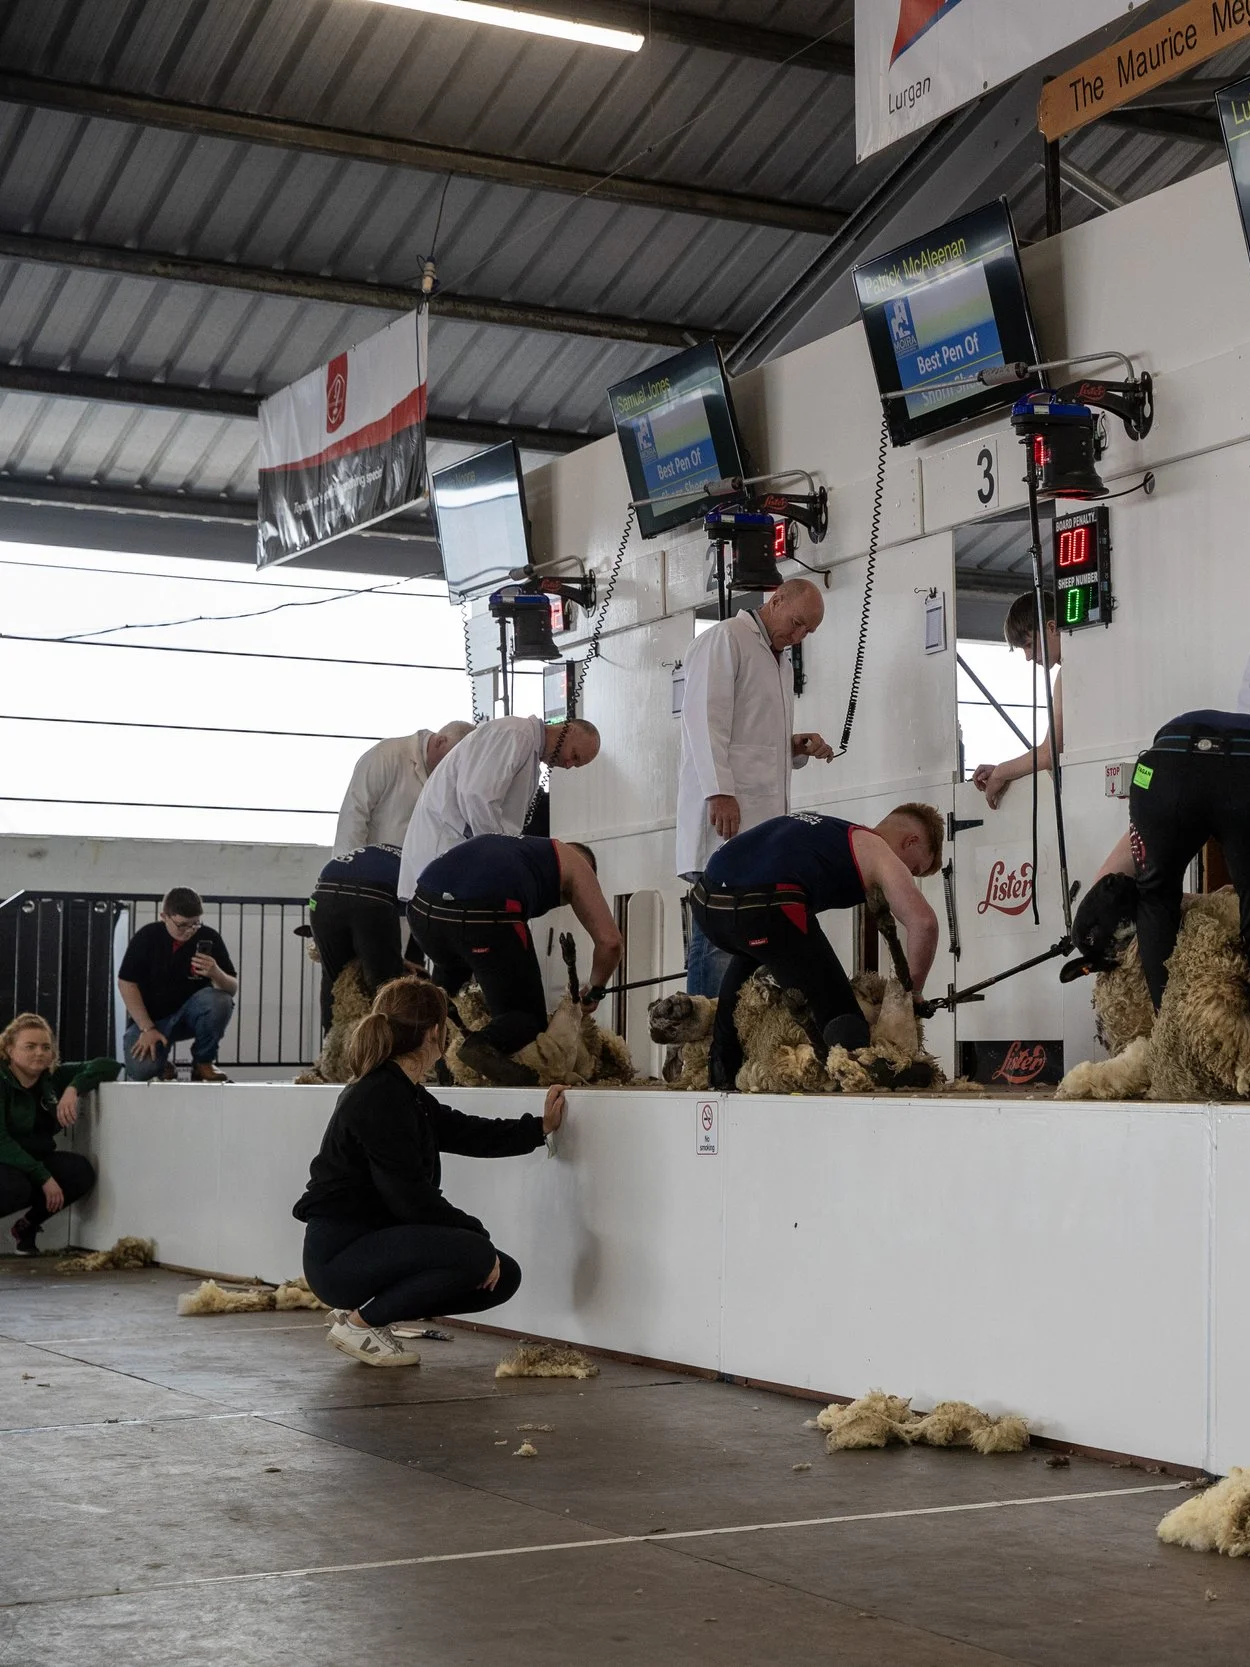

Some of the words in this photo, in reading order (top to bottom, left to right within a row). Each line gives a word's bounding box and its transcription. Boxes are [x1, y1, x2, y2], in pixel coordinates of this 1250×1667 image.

[1069, 76, 1104, 112] The
[1117, 24, 1198, 88] Maurice
[889, 77, 931, 115] Lurgan
[864, 264, 903, 297] Patrick
[902, 238, 967, 280] McAleenan
[893, 335, 917, 352] MOIRA
[917, 352, 942, 375] Best
[942, 345, 964, 365] Pen
[964, 332, 979, 356] Of
[616, 386, 647, 413] Samuel
[647, 377, 670, 401] Jones
[1077, 383, 1106, 400] Lister
[657, 464, 674, 480] Best
[674, 457, 691, 472] Pen
[690, 448, 702, 467] Of
[977, 449, 994, 504] 3
[1056, 518, 1072, 532] BOARD
[1060, 528, 1085, 566] 00
[1058, 577, 1075, 590] SHEEP
[1075, 572, 1098, 585] NUMBER
[1106, 767, 1120, 777] STOP
[977, 860, 1034, 916] Lister
[992, 1040, 1046, 1085] Lister
